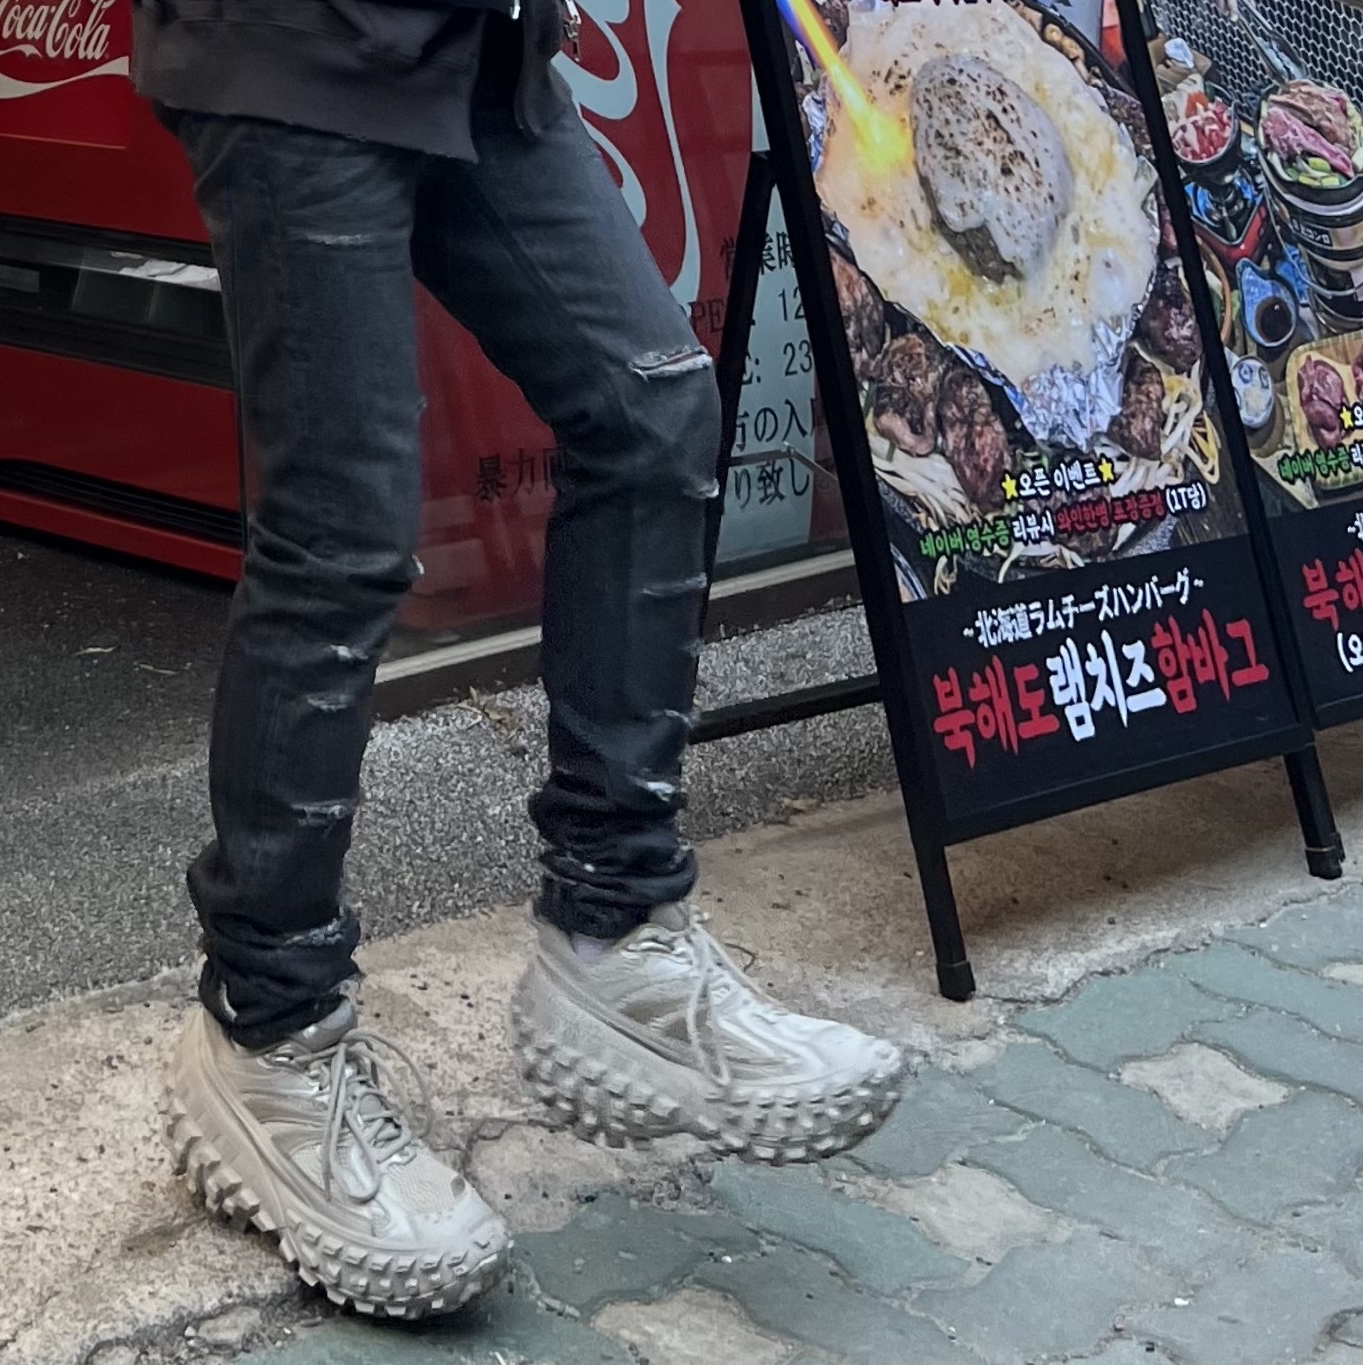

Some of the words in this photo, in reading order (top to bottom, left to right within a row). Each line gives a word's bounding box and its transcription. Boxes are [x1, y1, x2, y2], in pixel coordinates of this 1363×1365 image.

[1018, 468, 1051, 497] 오픈
[1053, 463, 1101, 492] 이벤트
[920, 530, 964, 557] 네이버
[965, 521, 1011, 552] 영수증
[1012, 510, 1056, 540] 리뷰시
[931, 608, 1270, 769] 북해도램치즈함바그
